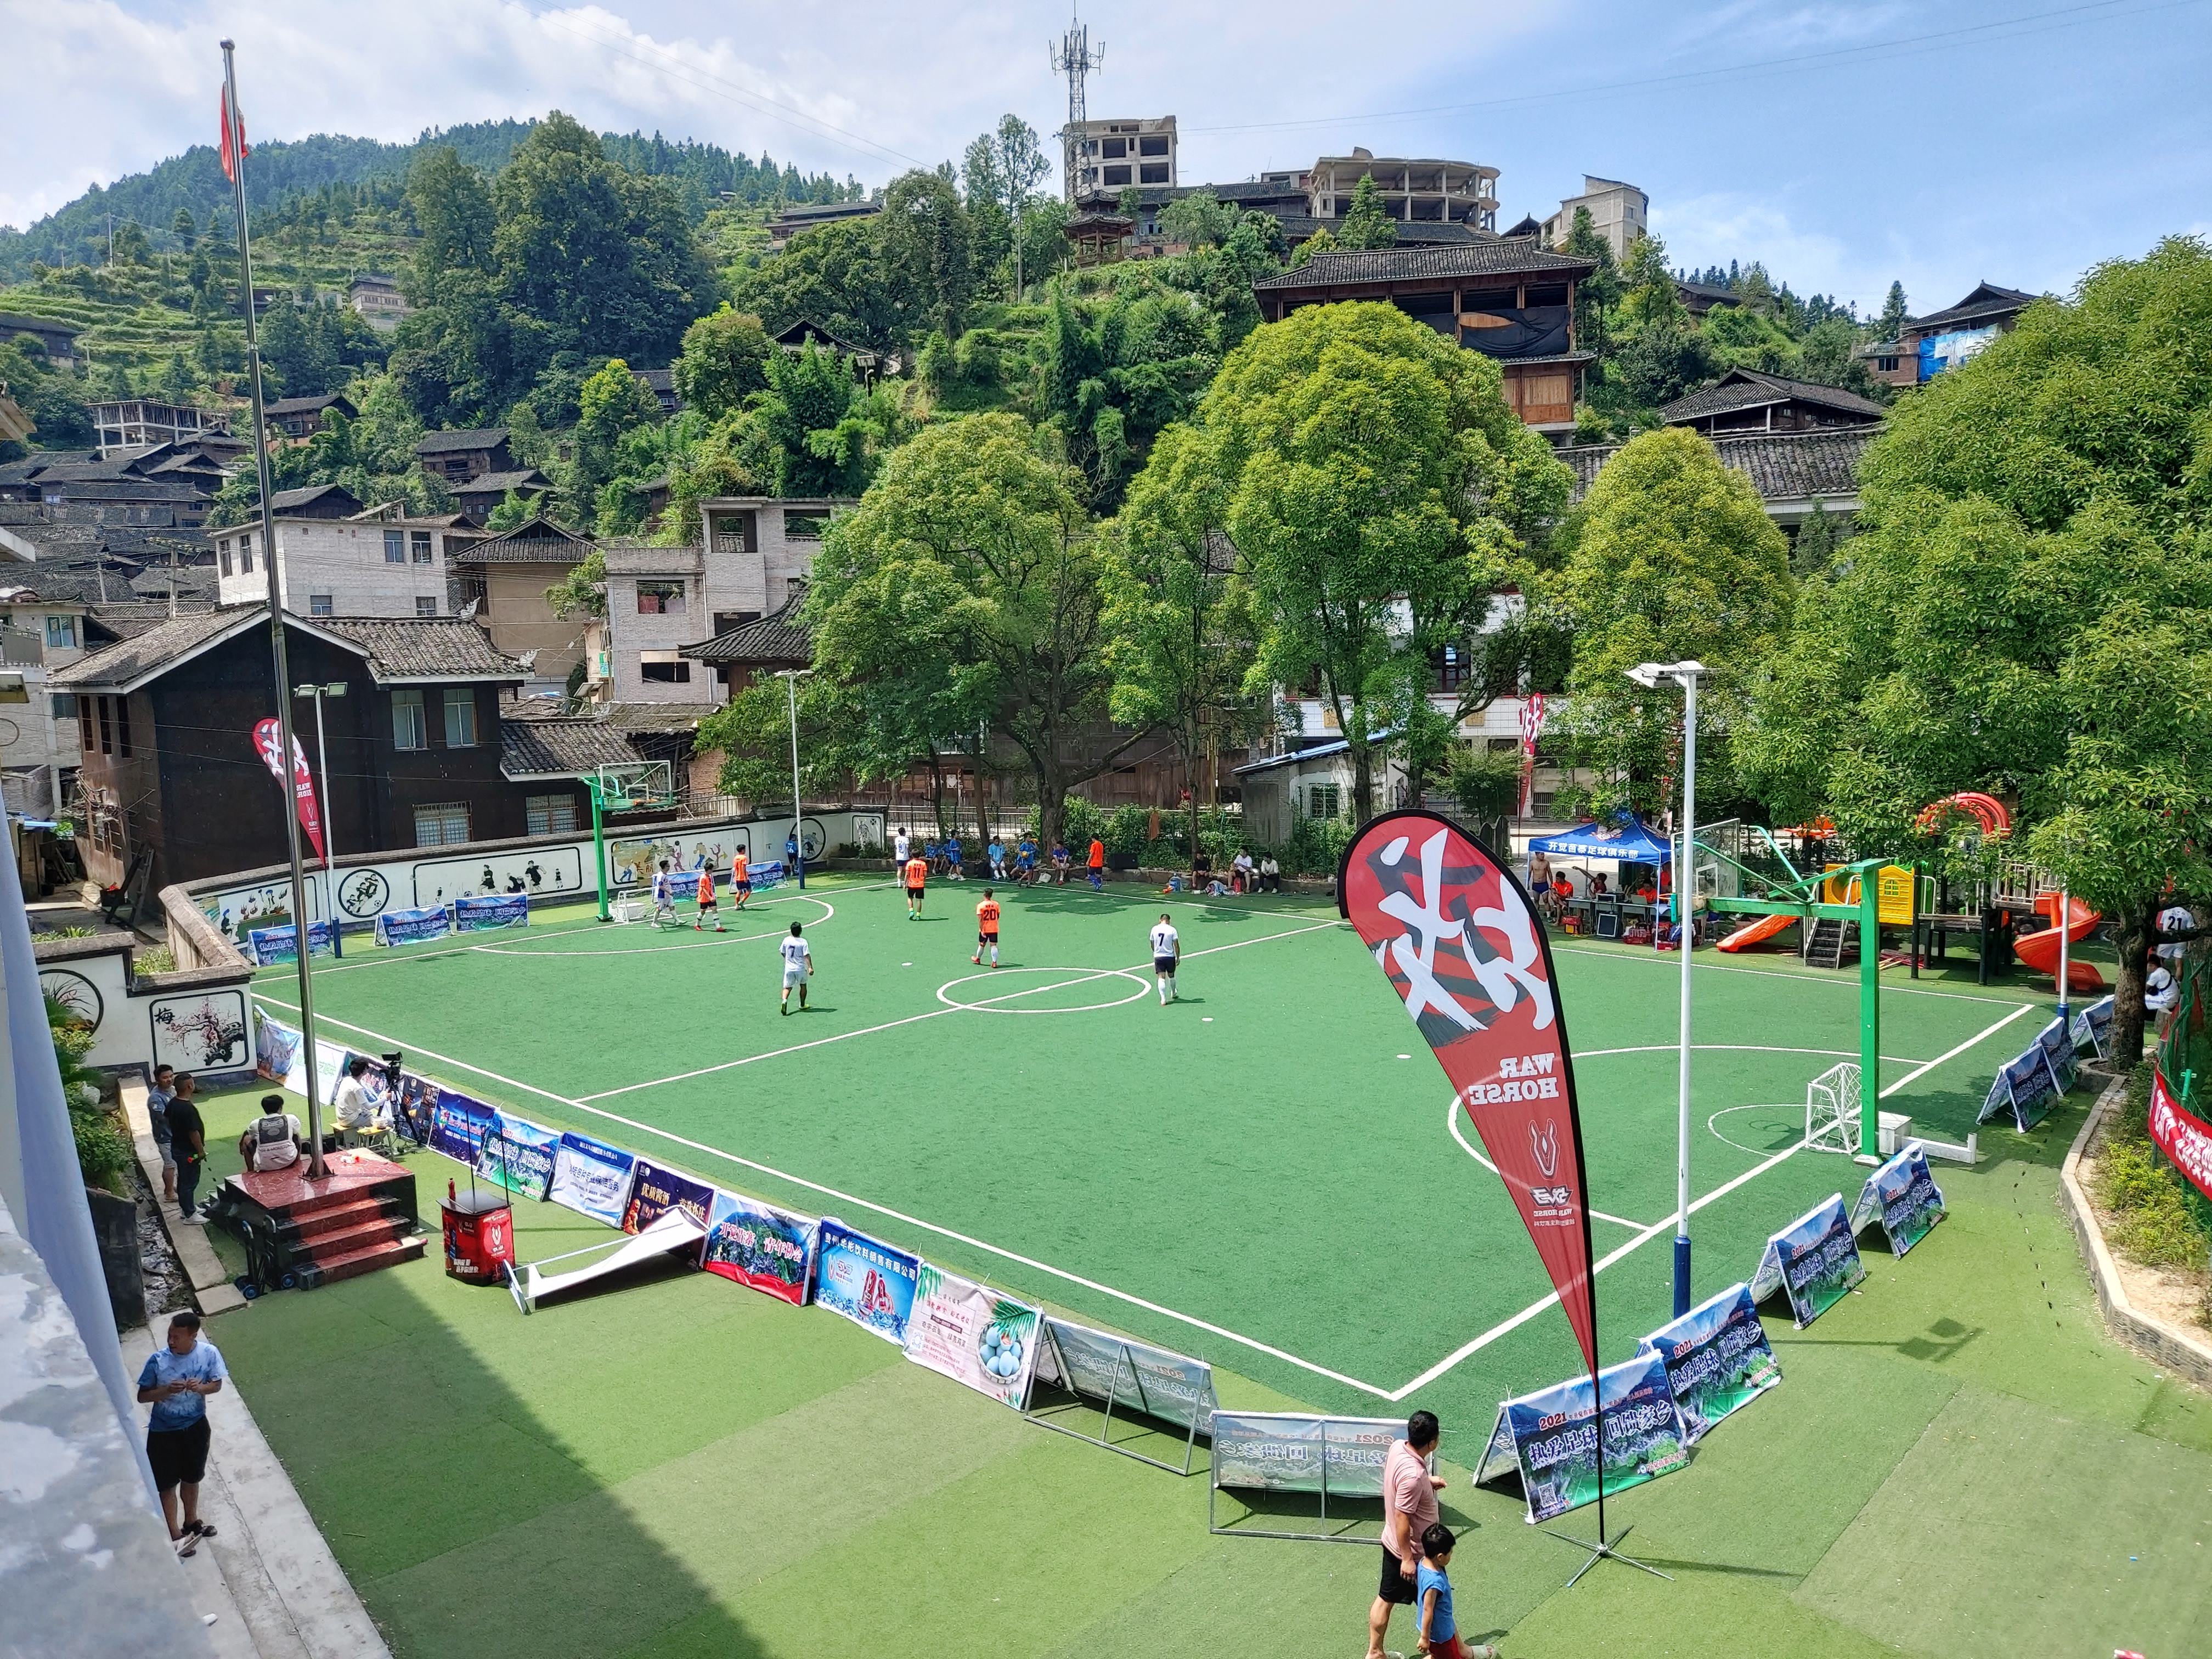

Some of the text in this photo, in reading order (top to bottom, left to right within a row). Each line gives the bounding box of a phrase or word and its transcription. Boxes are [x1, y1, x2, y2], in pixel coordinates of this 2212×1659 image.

[983, 909, 996, 921] 20
[2168, 916, 2182, 930] 21
[1158, 933, 1165, 947] 7
[788, 945, 795, 958] 7
[154, 1007, 175, 1025] 梅
[501, 1128, 514, 1139] 2021
[764, 1237, 804, 1263] 青年协会
[1791, 1244, 1805, 1260] 2021
[1674, 1339, 1693, 1359] 2021
[1538, 1410, 1567, 1431] 2021
[1529, 1399, 1674, 1471] 热爱足球 回馈家乡
